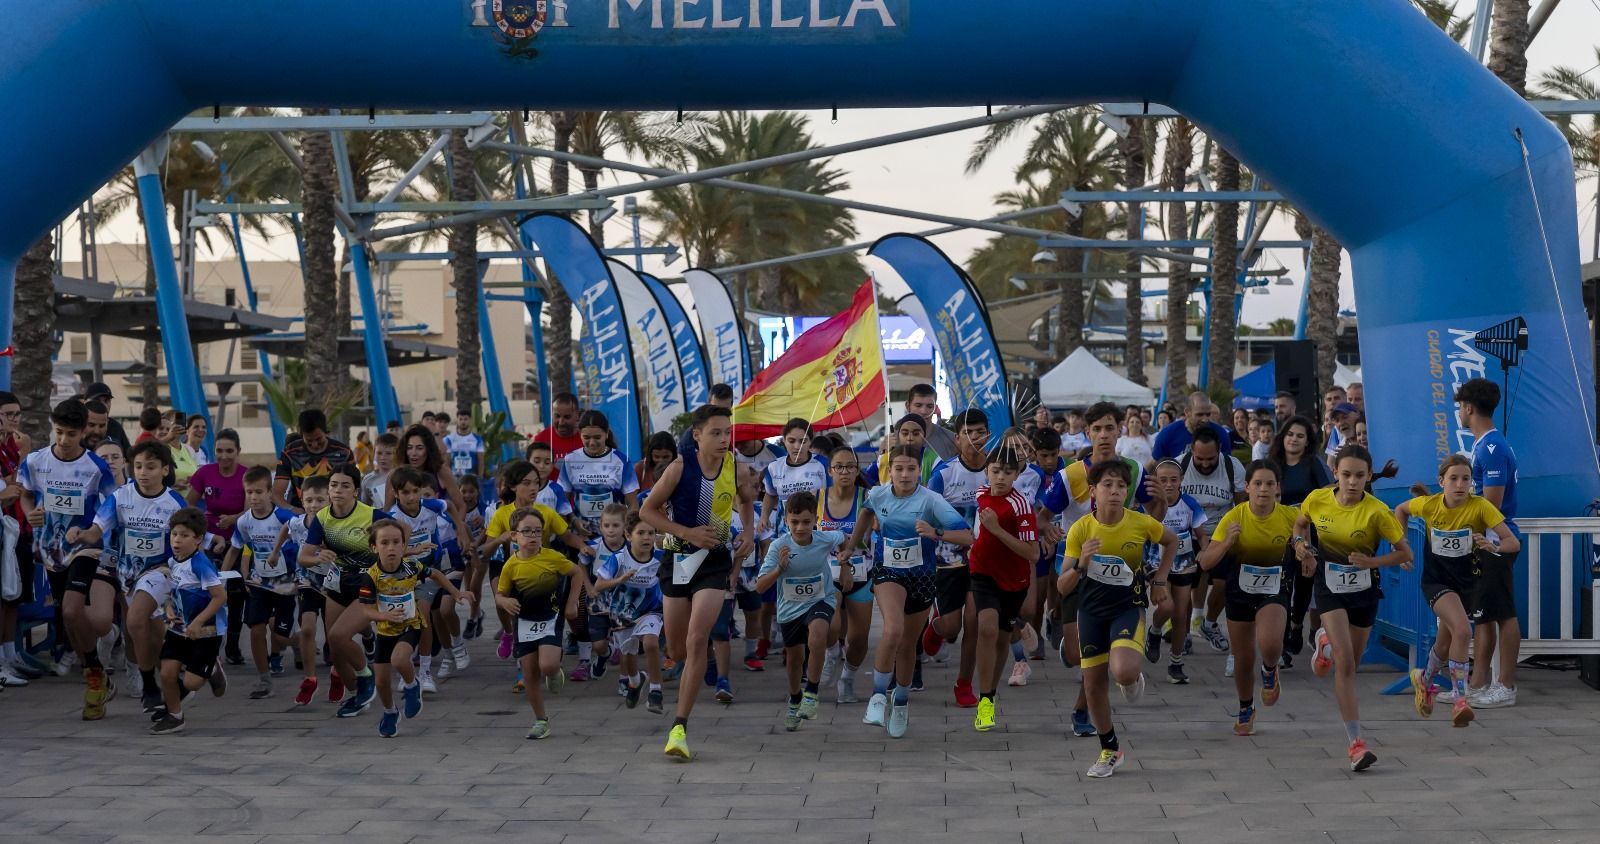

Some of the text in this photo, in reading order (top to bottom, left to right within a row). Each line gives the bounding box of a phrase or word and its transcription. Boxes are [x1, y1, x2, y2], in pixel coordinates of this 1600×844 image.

[55, 495, 73, 508] 24
[589, 501, 605, 511] 76
[136, 538, 154, 550] 25
[1442, 537, 1461, 550] 28
[892, 547, 911, 561] 67
[1102, 564, 1121, 577] 70
[1252, 574, 1270, 586] 77
[1338, 573, 1358, 585] 12
[795, 584, 814, 595] 66
[529, 622, 547, 634] 49
